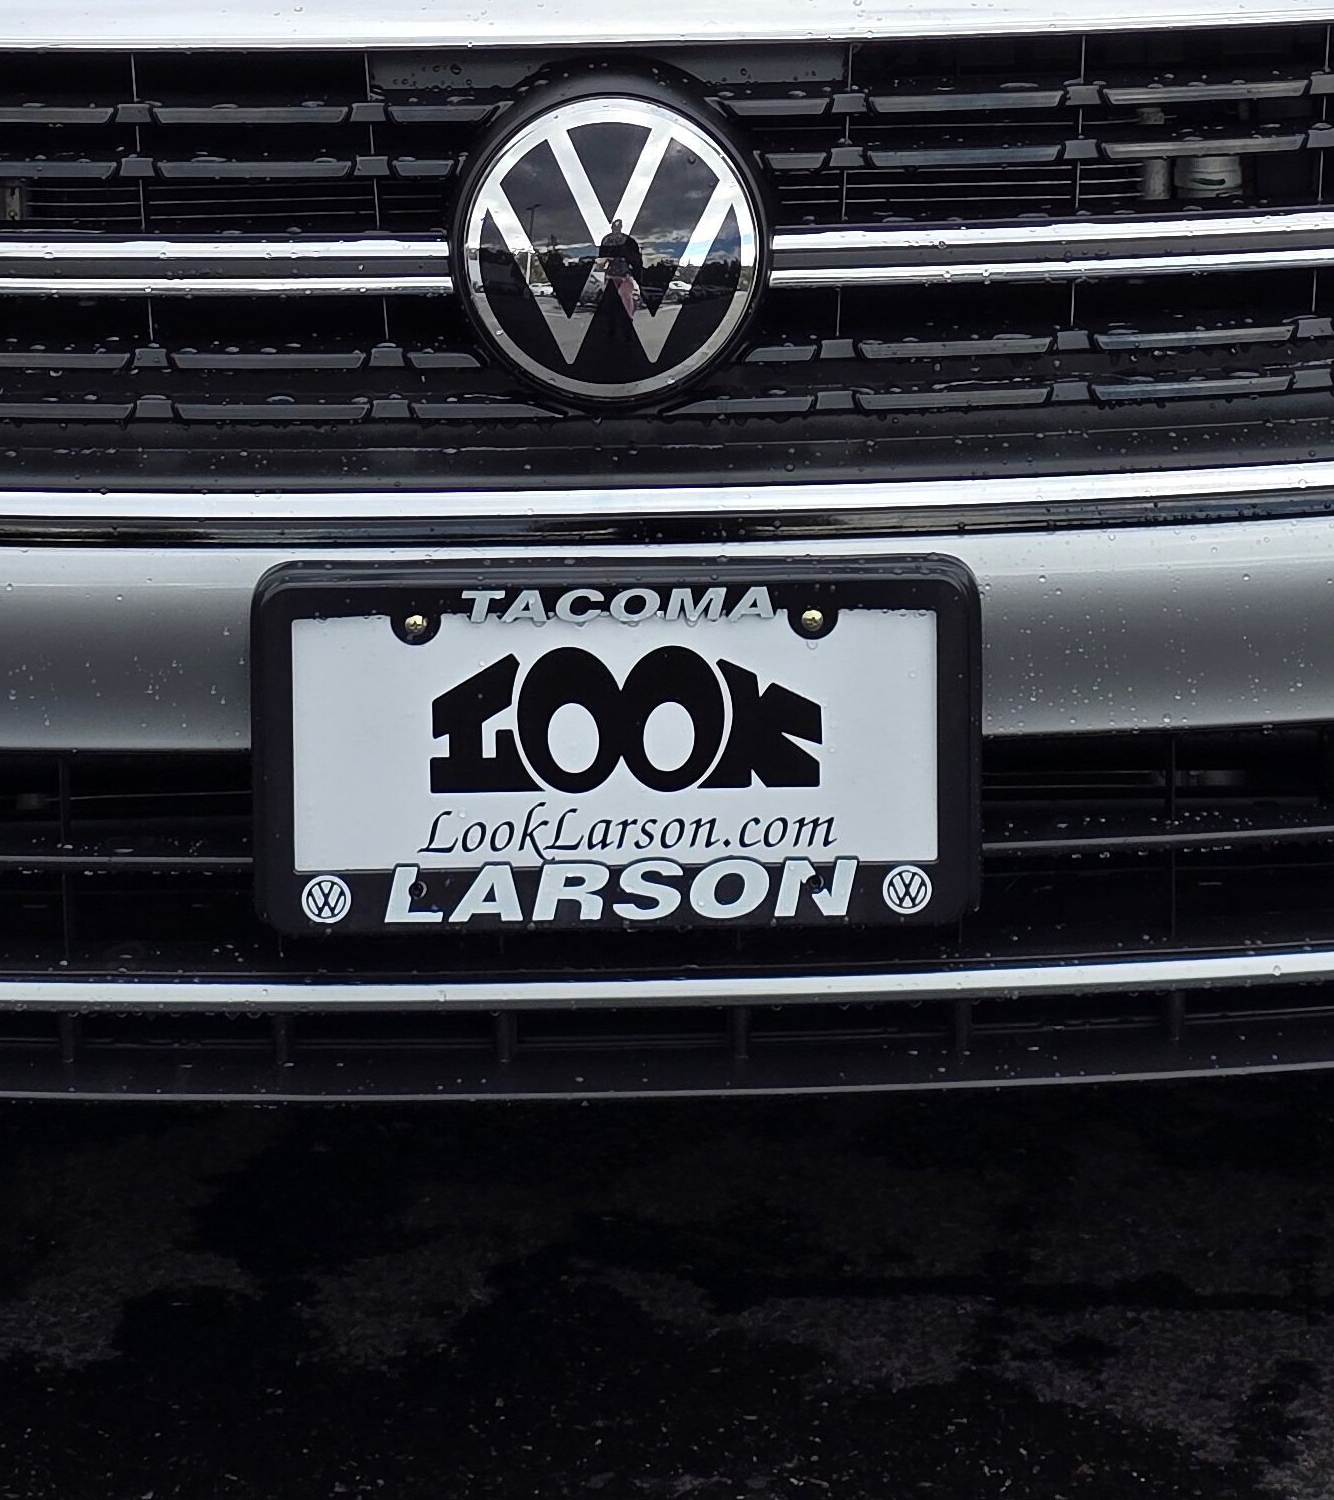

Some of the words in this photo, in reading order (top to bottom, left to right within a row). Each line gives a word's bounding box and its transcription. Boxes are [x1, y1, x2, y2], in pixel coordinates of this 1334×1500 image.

[461, 586, 775, 623] TACOMA
[429, 645, 823, 794] LOOK
[417, 801, 837, 861] LookLarson.com
[384, 856, 859, 923] LARSON
